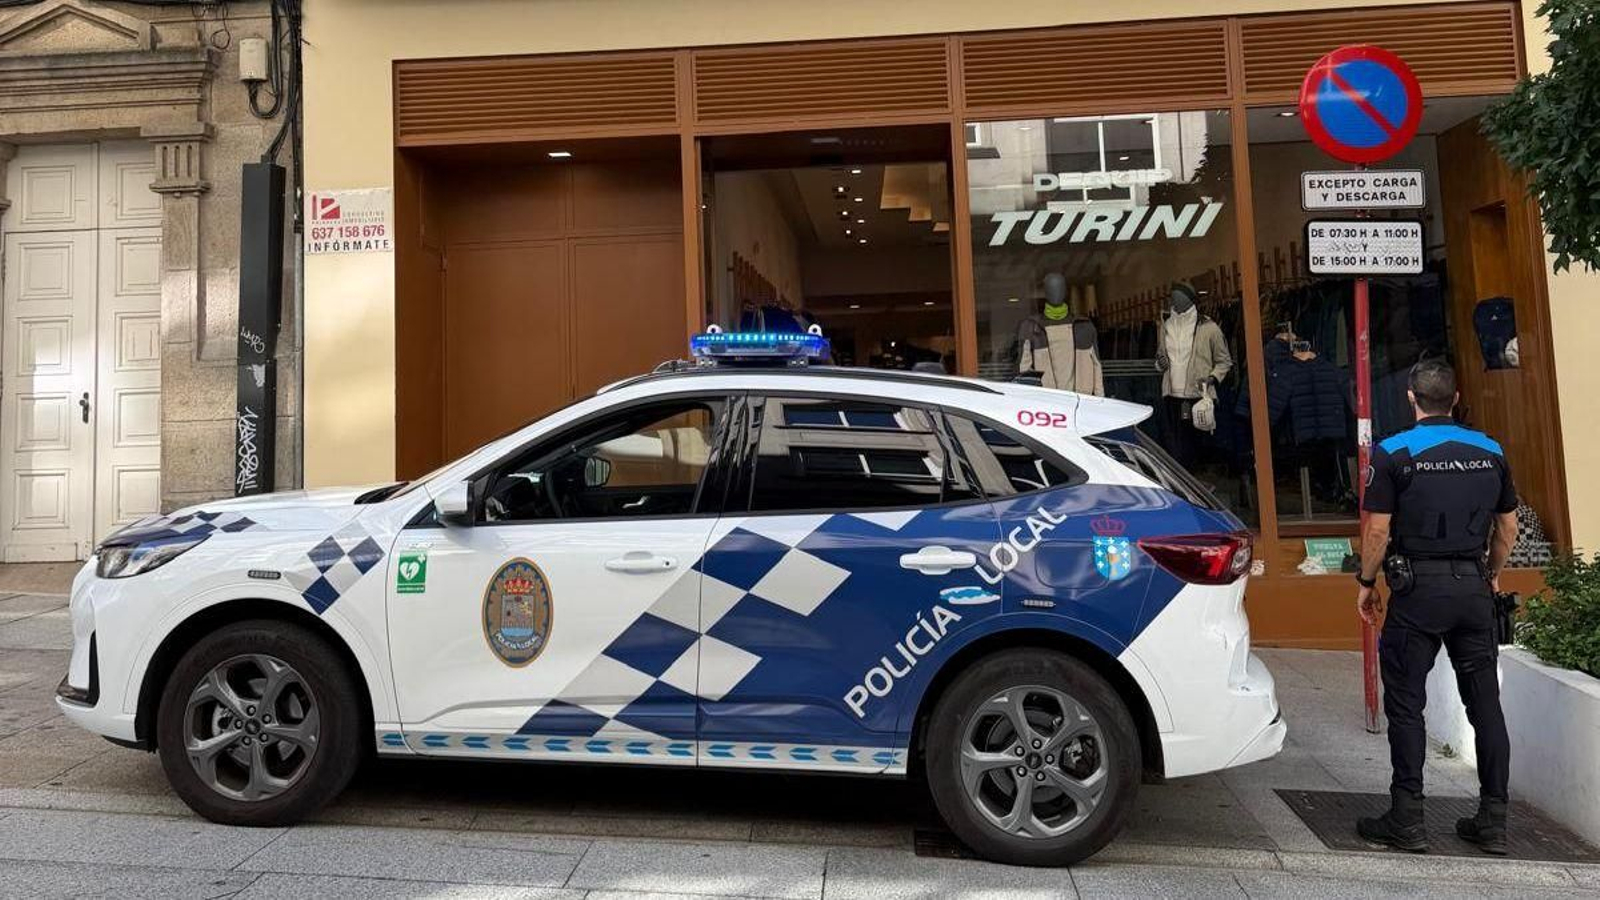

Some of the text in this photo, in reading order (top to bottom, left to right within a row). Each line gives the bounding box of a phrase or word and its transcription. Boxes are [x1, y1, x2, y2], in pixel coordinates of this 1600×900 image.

[1308, 177, 1418, 189] EXCEPTO CARGA
[1322, 191, 1406, 201] Y DESCARGA
[312, 224, 385, 240] 637 158 676
[1311, 228, 1325, 238] DE
[1360, 228, 1367, 238] H
[1372, 228, 1379, 238] A
[1411, 228, 1418, 238] H
[1361, 243, 1368, 252] Y
[1312, 256, 1326, 266] DE
[1359, 256, 1367, 266] H
[1372, 256, 1379, 266] A
[1412, 256, 1419, 266] H
[1017, 410, 1067, 428] 092
[1416, 460, 1494, 471] POLICÍA LOCAL
[843, 506, 1067, 718] POLICÍA LOCAL
